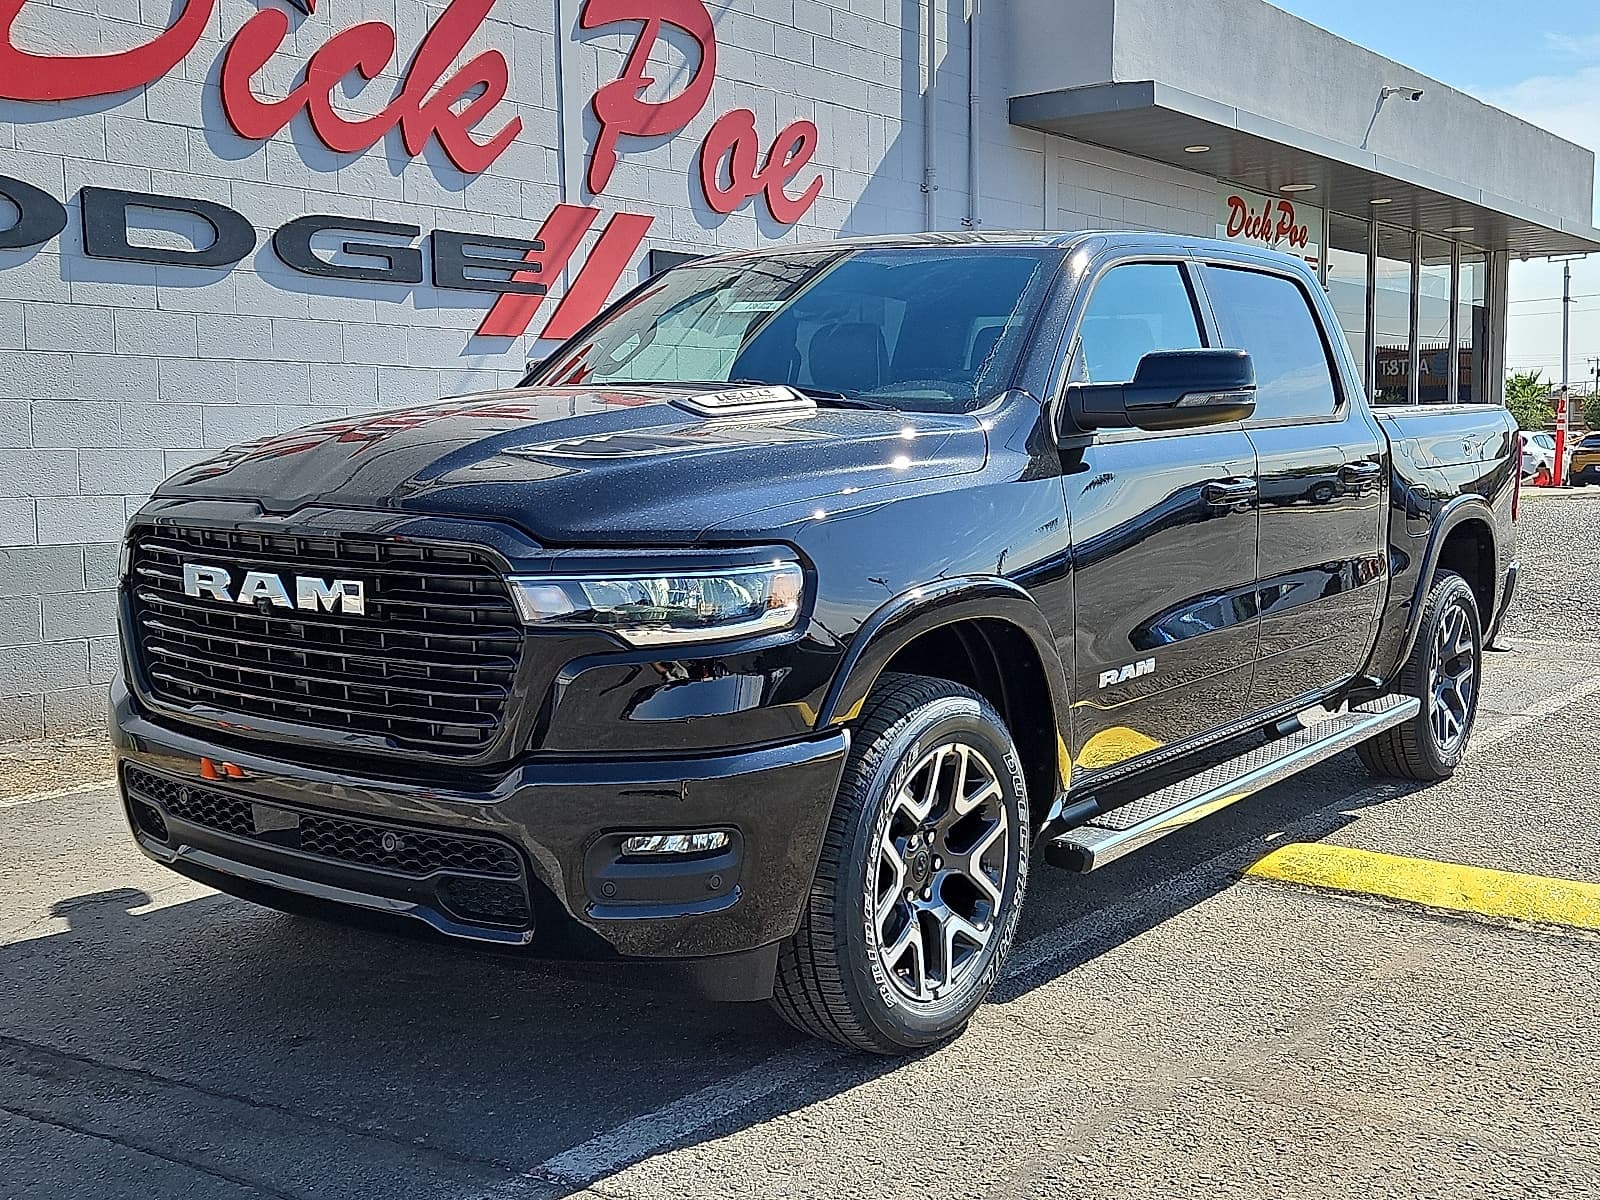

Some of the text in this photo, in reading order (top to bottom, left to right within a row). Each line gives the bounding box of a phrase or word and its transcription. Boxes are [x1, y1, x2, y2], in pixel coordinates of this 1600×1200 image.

[580, 0, 824, 225] Poe
[1226, 195, 1309, 249] Dick Poe
[182, 562, 366, 617] RAM
[1098, 657, 1156, 689] RAM
[863, 740, 921, 1009] BRIDGESTONE
